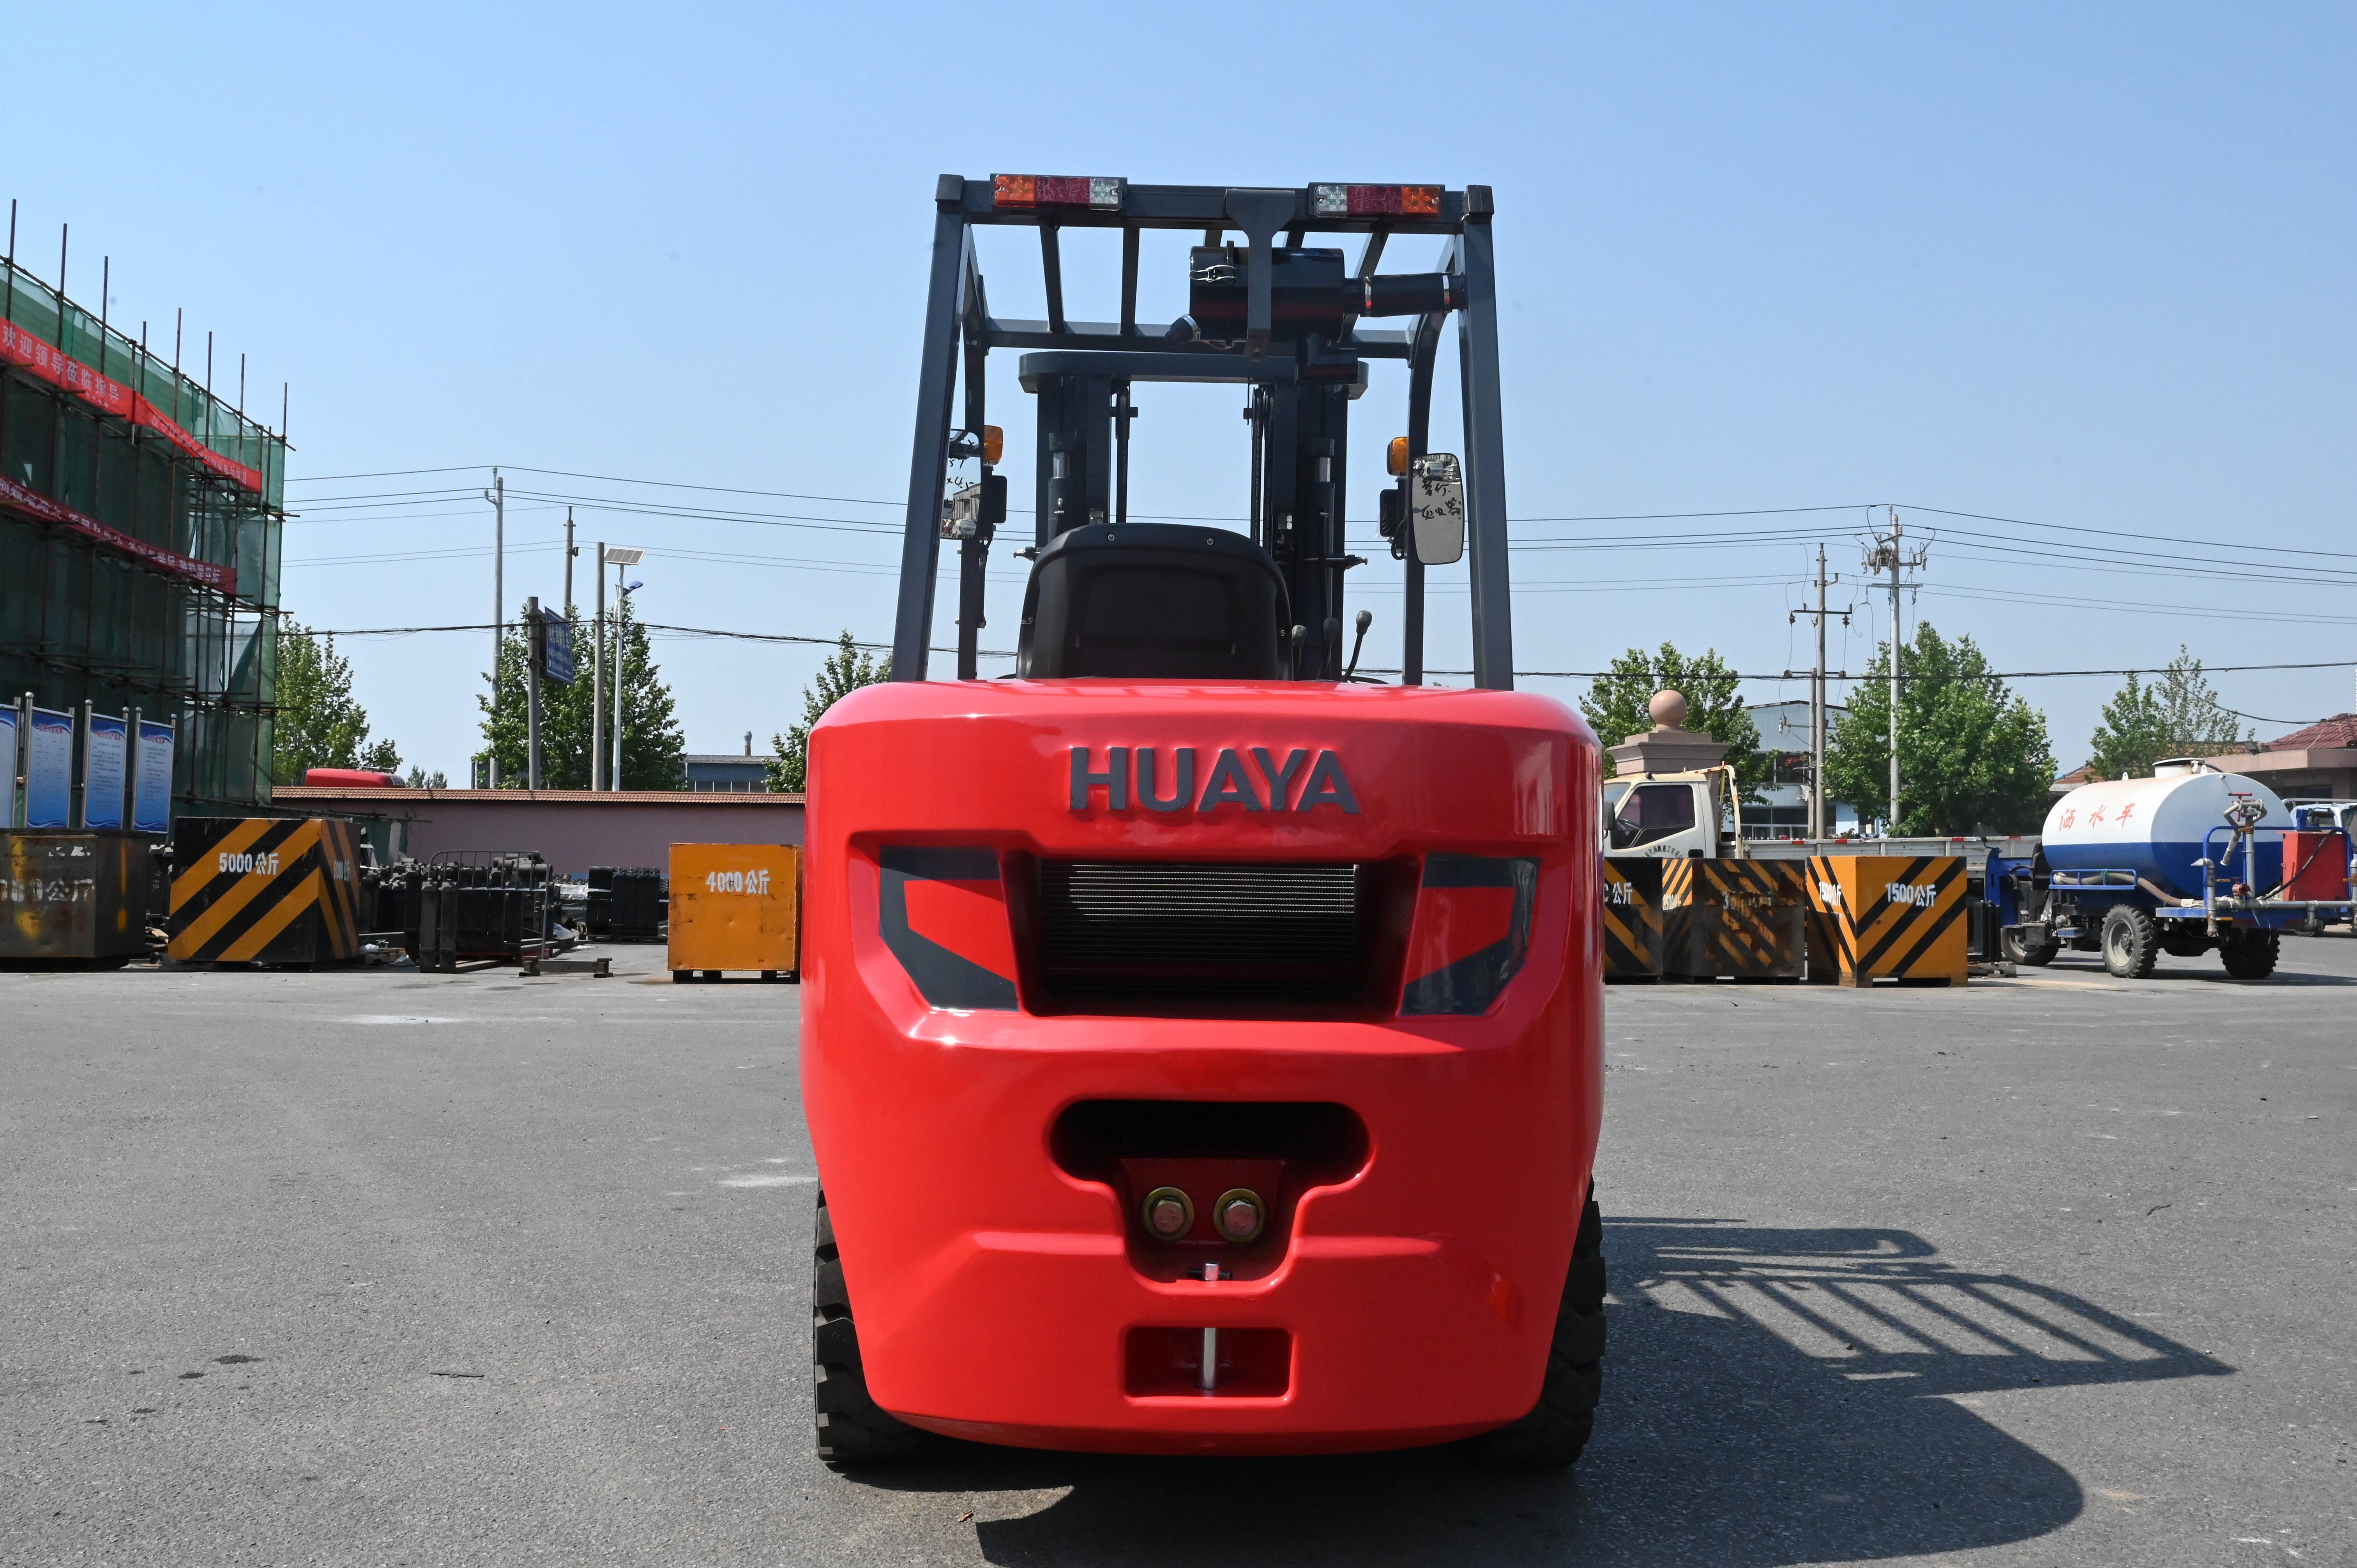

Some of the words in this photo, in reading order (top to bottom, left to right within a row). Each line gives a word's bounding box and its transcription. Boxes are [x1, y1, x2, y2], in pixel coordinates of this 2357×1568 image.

[2, 325, 119, 403] 欢迎领导莅临指导
[1070, 747, 1360, 814] HUAYA
[2059, 801, 2136, 832] 洒水车
[219, 852, 279, 876] 5000公斤
[705, 869, 770, 895] 4000公斤
[1818, 881, 1842, 907] 1500公斤
[1885, 882, 1936, 907] 1500公斤
